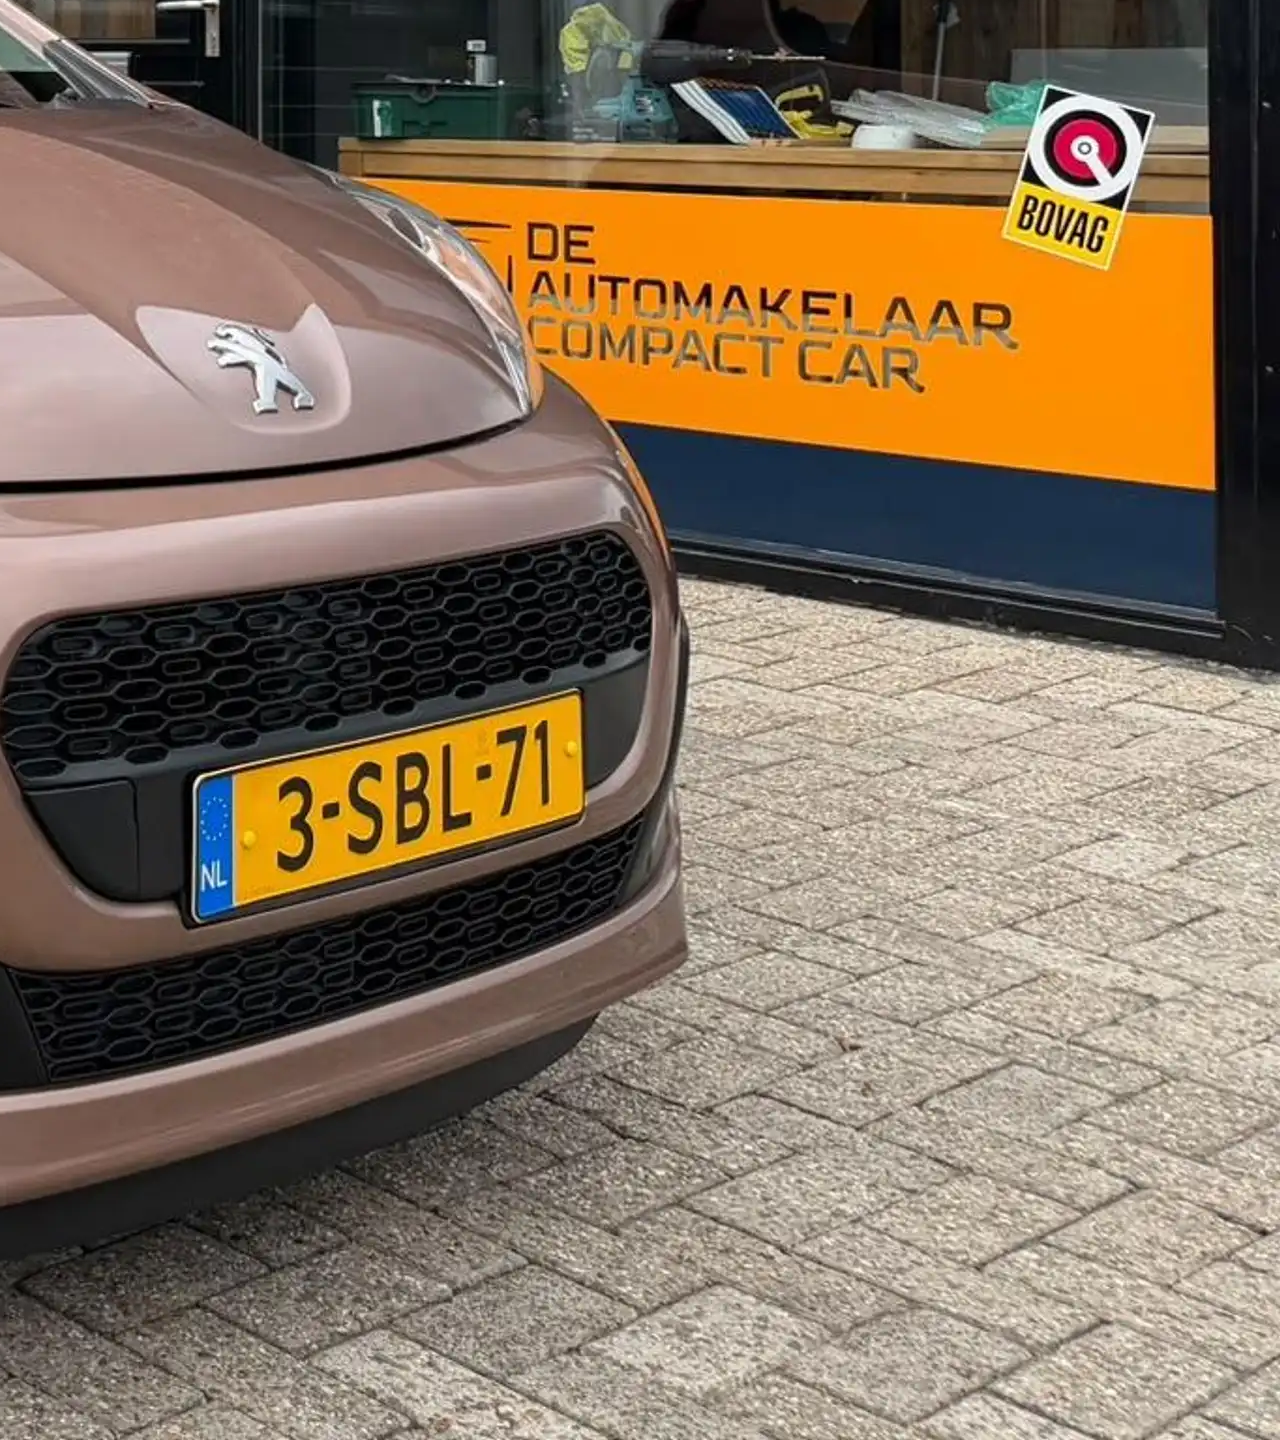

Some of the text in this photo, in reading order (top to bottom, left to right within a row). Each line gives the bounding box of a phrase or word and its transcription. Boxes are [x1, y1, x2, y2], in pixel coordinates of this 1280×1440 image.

[527, 221, 597, 265] DE
[1016, 194, 1109, 254] BOVAG
[528, 270, 1020, 350] AUTOMAKELAAR
[527, 314, 926, 394] COMPACT CAR
[276, 719, 550, 873] 3-SBL-71
[200, 859, 228, 893] NL
